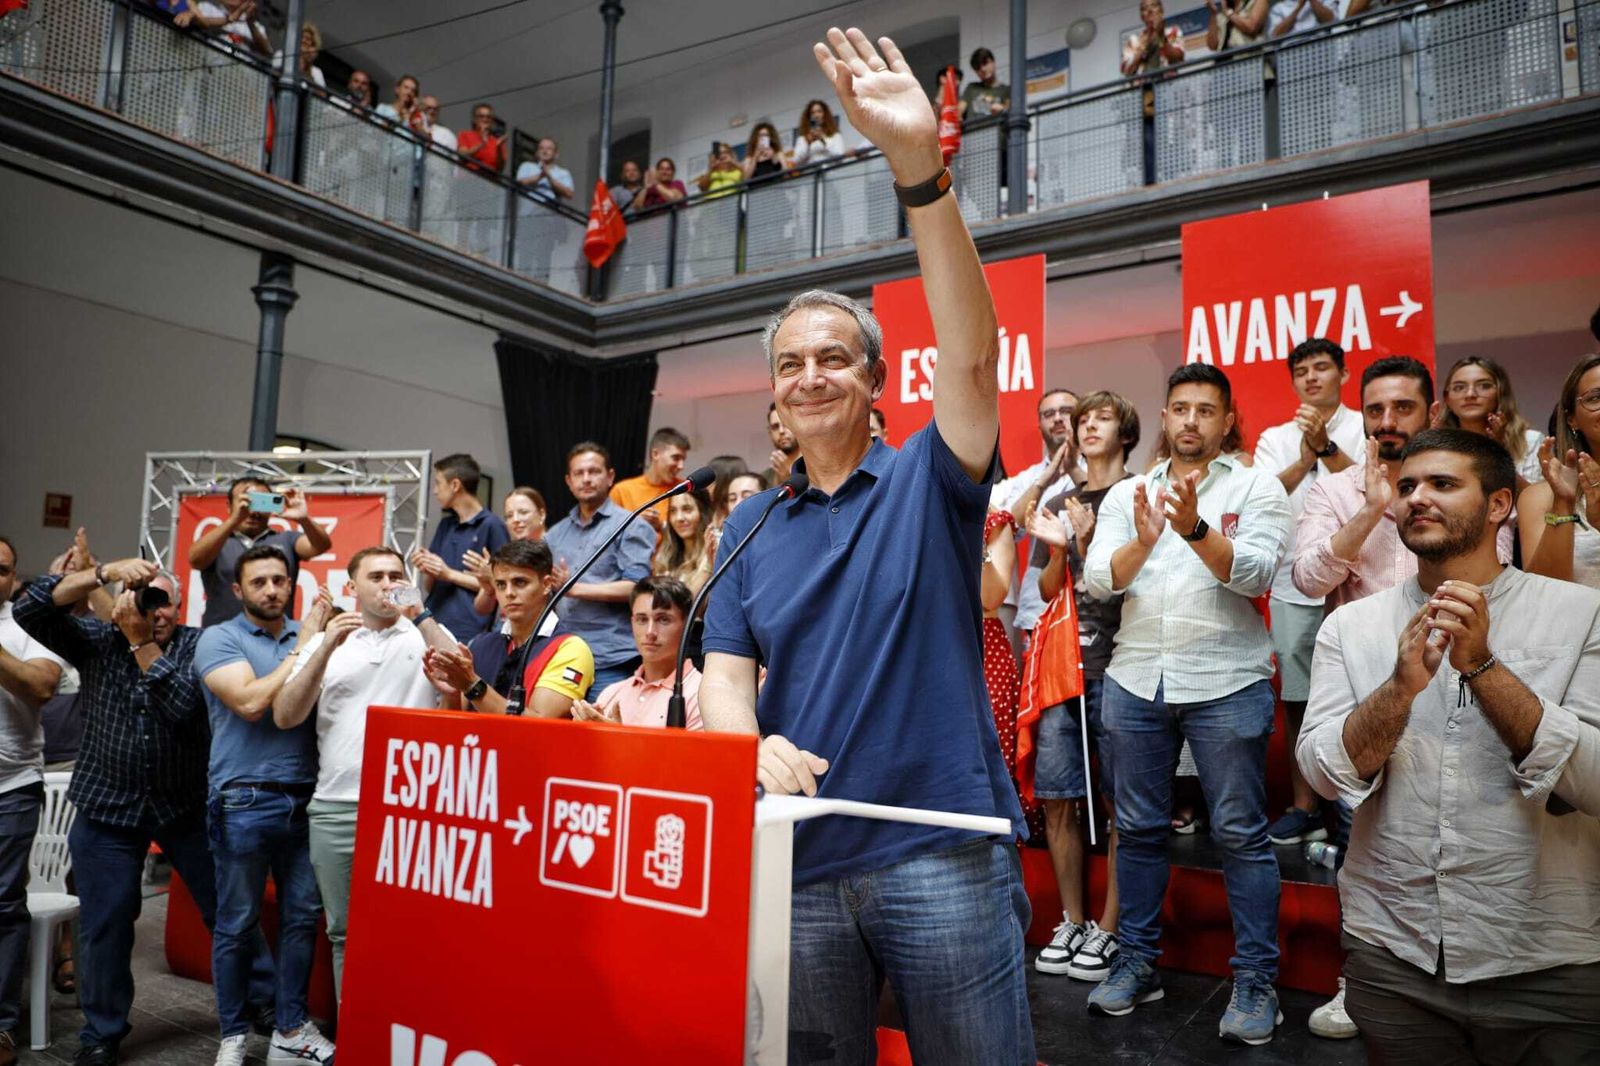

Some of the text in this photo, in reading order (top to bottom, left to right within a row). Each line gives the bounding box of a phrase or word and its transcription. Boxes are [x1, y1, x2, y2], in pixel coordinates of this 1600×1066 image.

[900, 326, 1035, 404] ESÑA
[1186, 284, 1373, 367] AVANZA
[382, 734, 499, 822] ESPAÑA
[553, 799, 611, 837] PSOE
[375, 815, 493, 908] AVANZA
